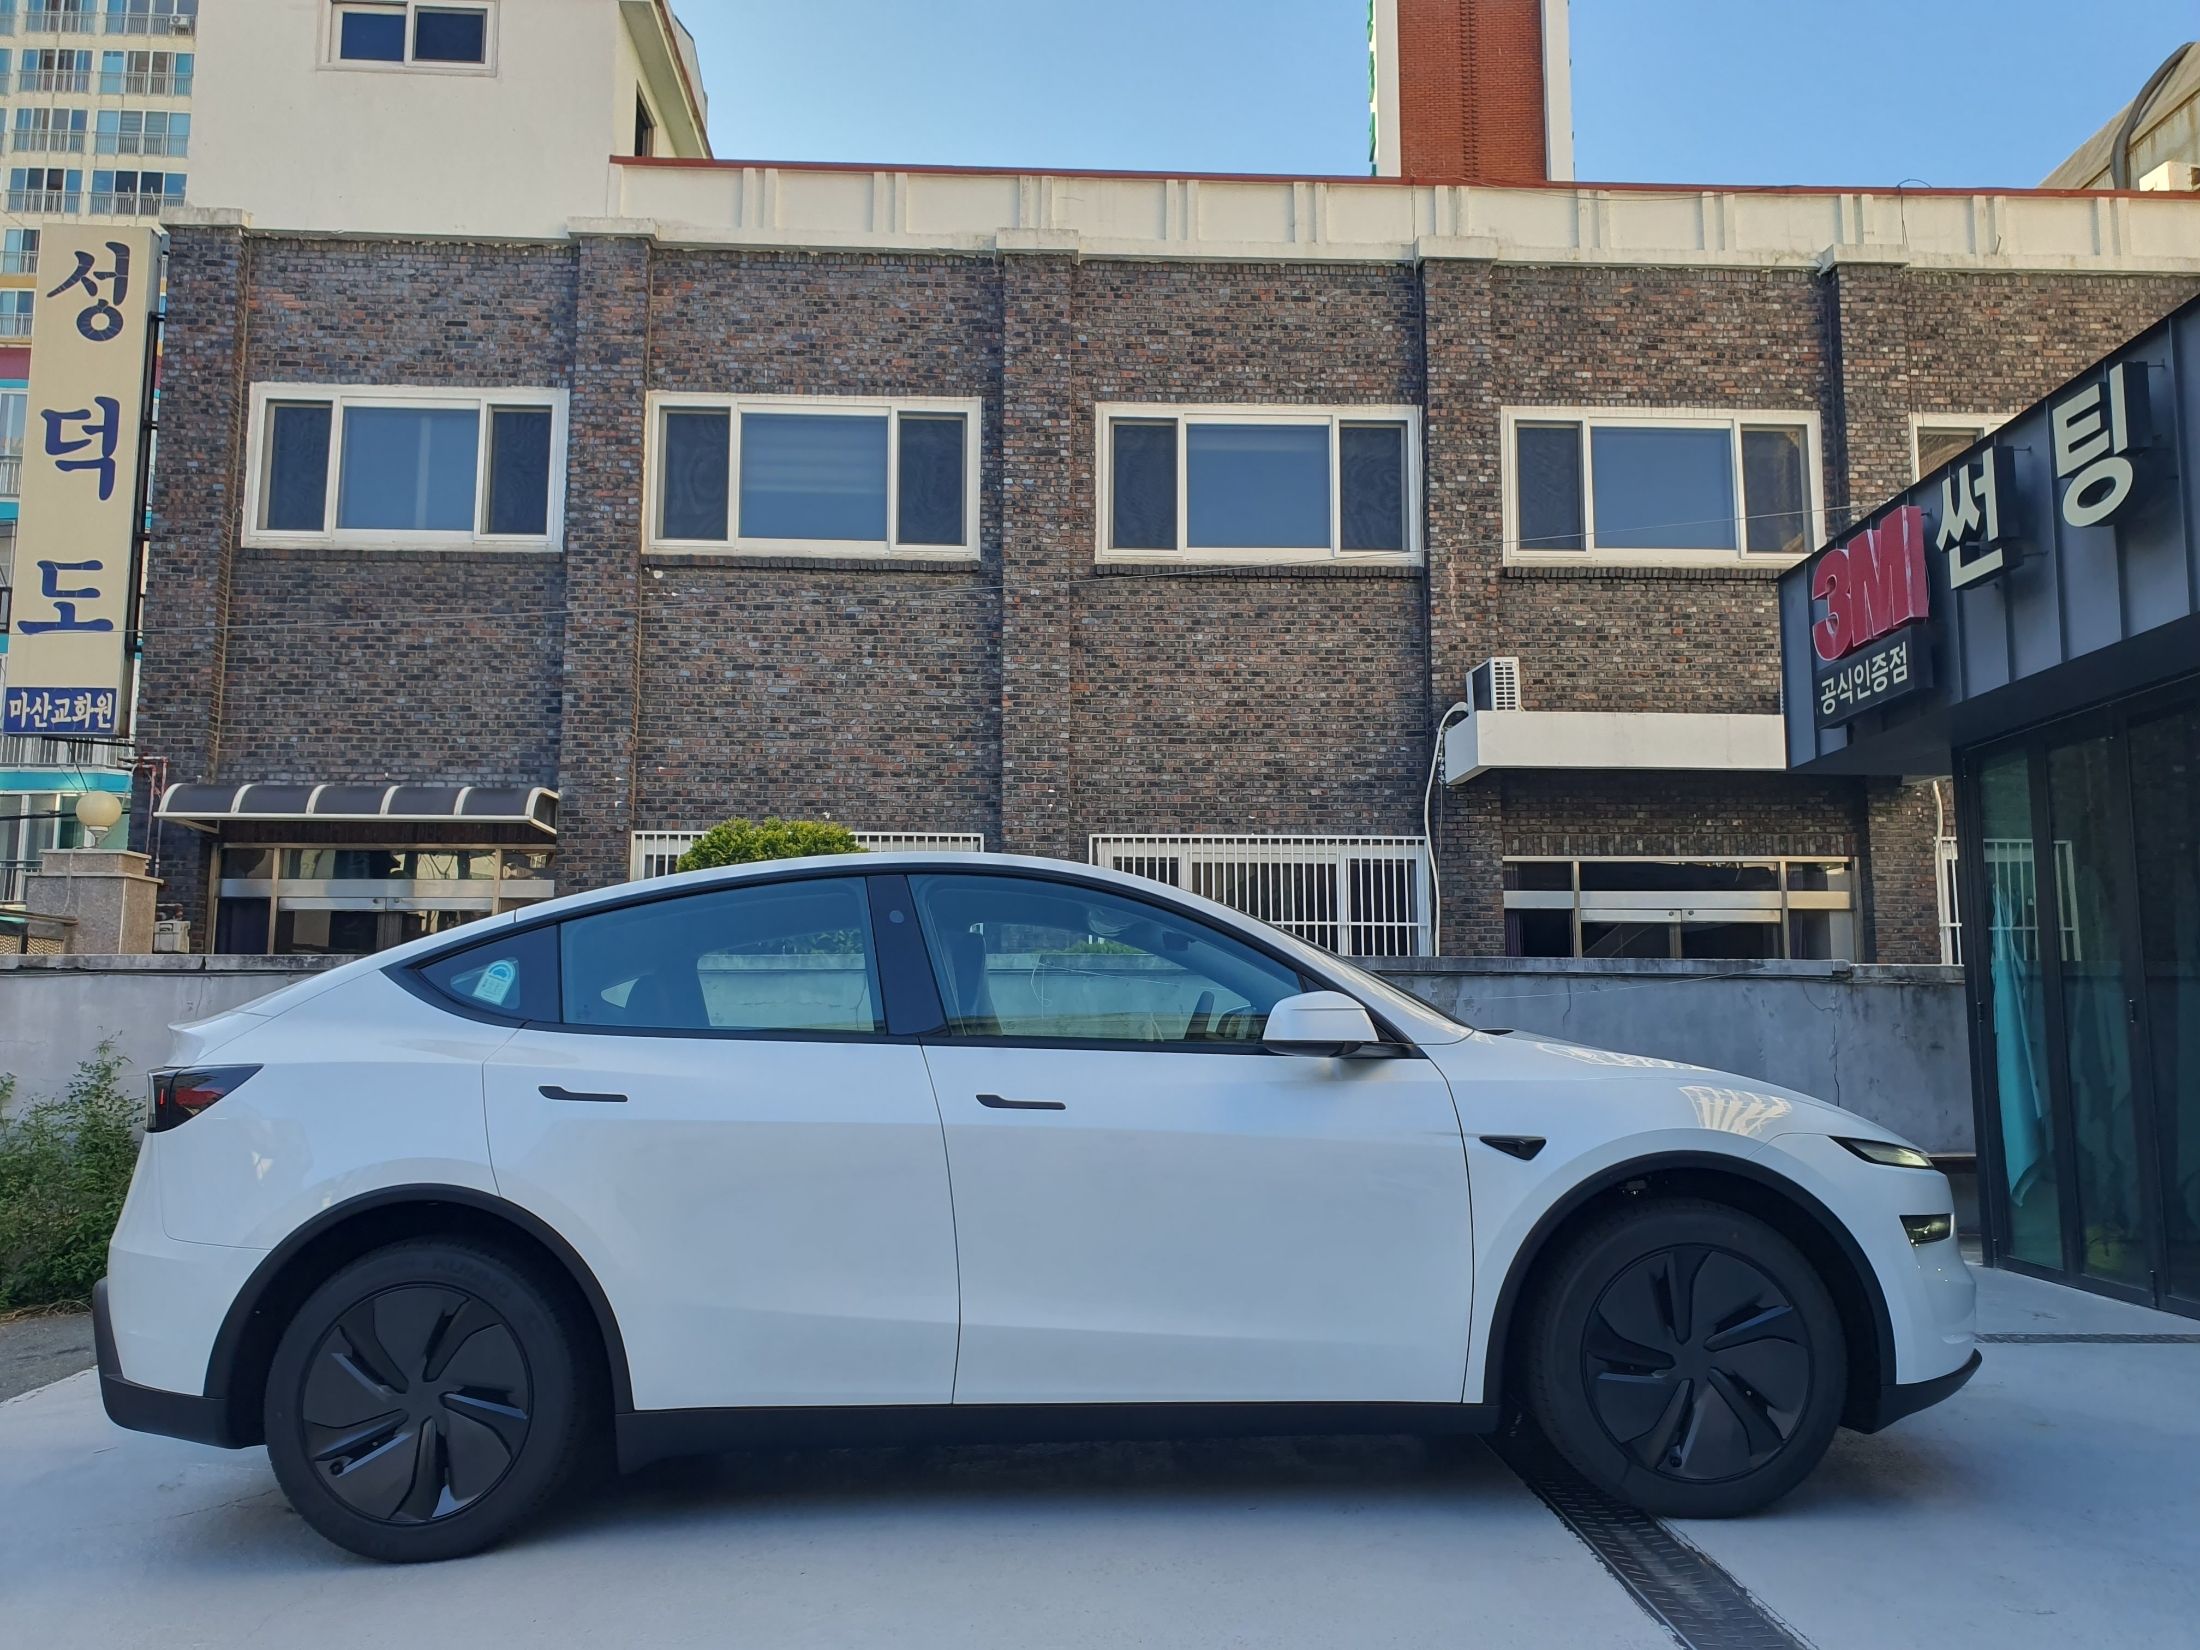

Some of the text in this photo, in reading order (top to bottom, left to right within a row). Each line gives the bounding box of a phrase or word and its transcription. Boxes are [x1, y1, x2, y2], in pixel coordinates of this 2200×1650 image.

[17, 241, 131, 635] 성덕도
[1811, 362, 2134, 661] 3M 썬팅
[9, 691, 113, 728] 마산교화원
[1820, 641, 1908, 715] 공식인증점
